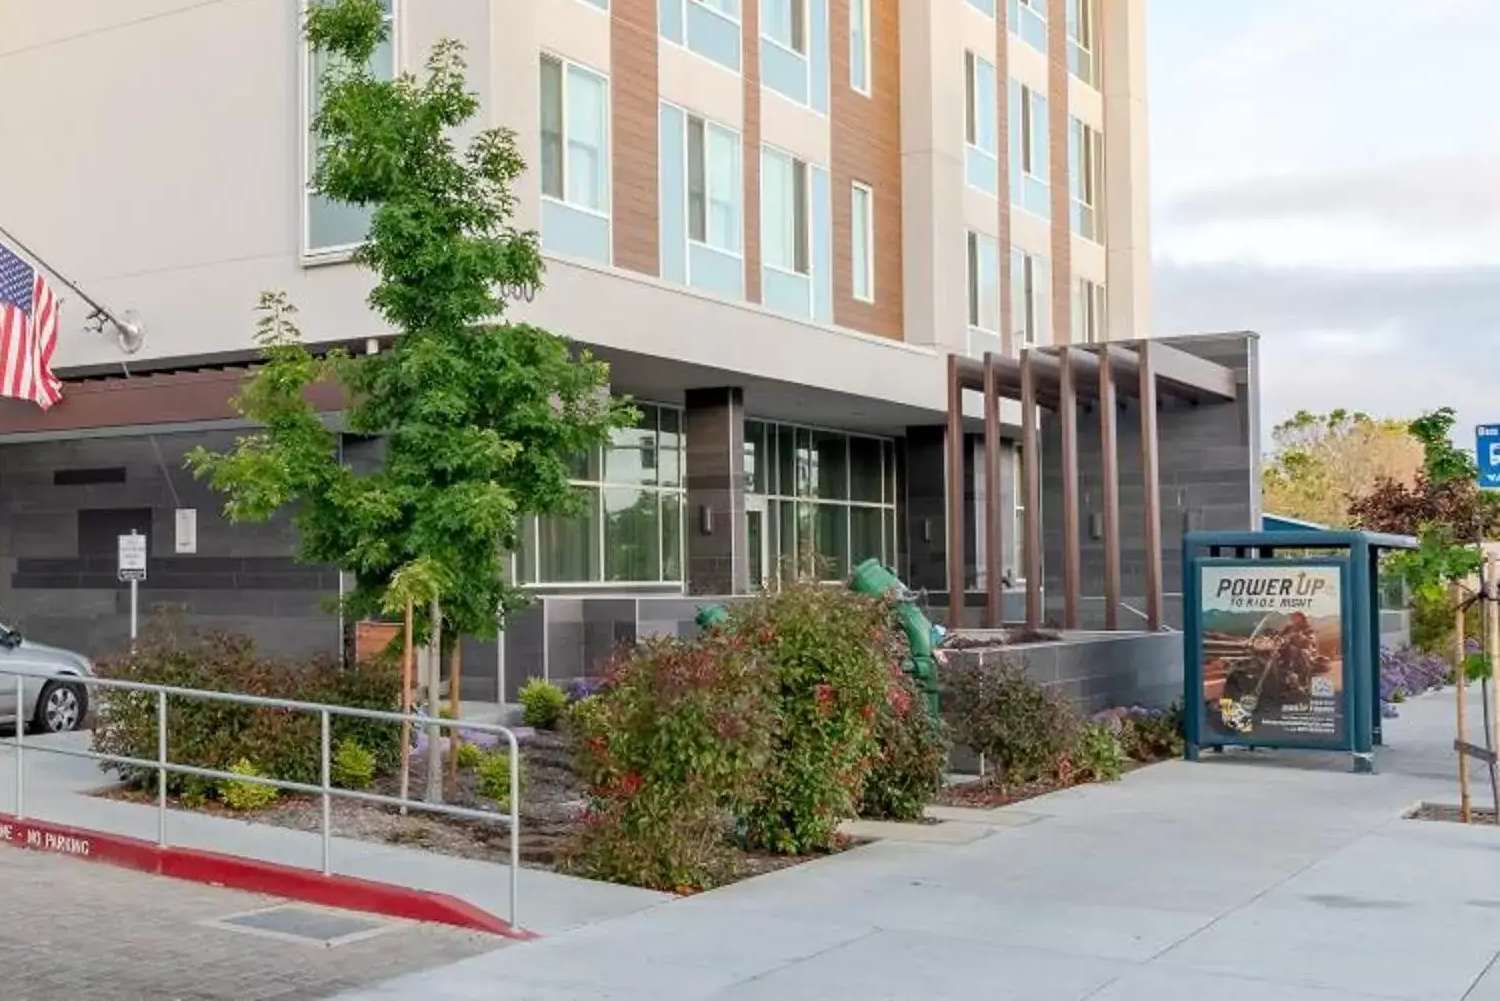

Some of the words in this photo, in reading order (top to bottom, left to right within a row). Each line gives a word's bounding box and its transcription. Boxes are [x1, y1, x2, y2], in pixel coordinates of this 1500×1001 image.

[1216, 578, 1293, 598] POWER
[1296, 574, 1325, 595] UP
[26, 828, 42, 847] NO
[45, 832, 90, 856] PARKING
